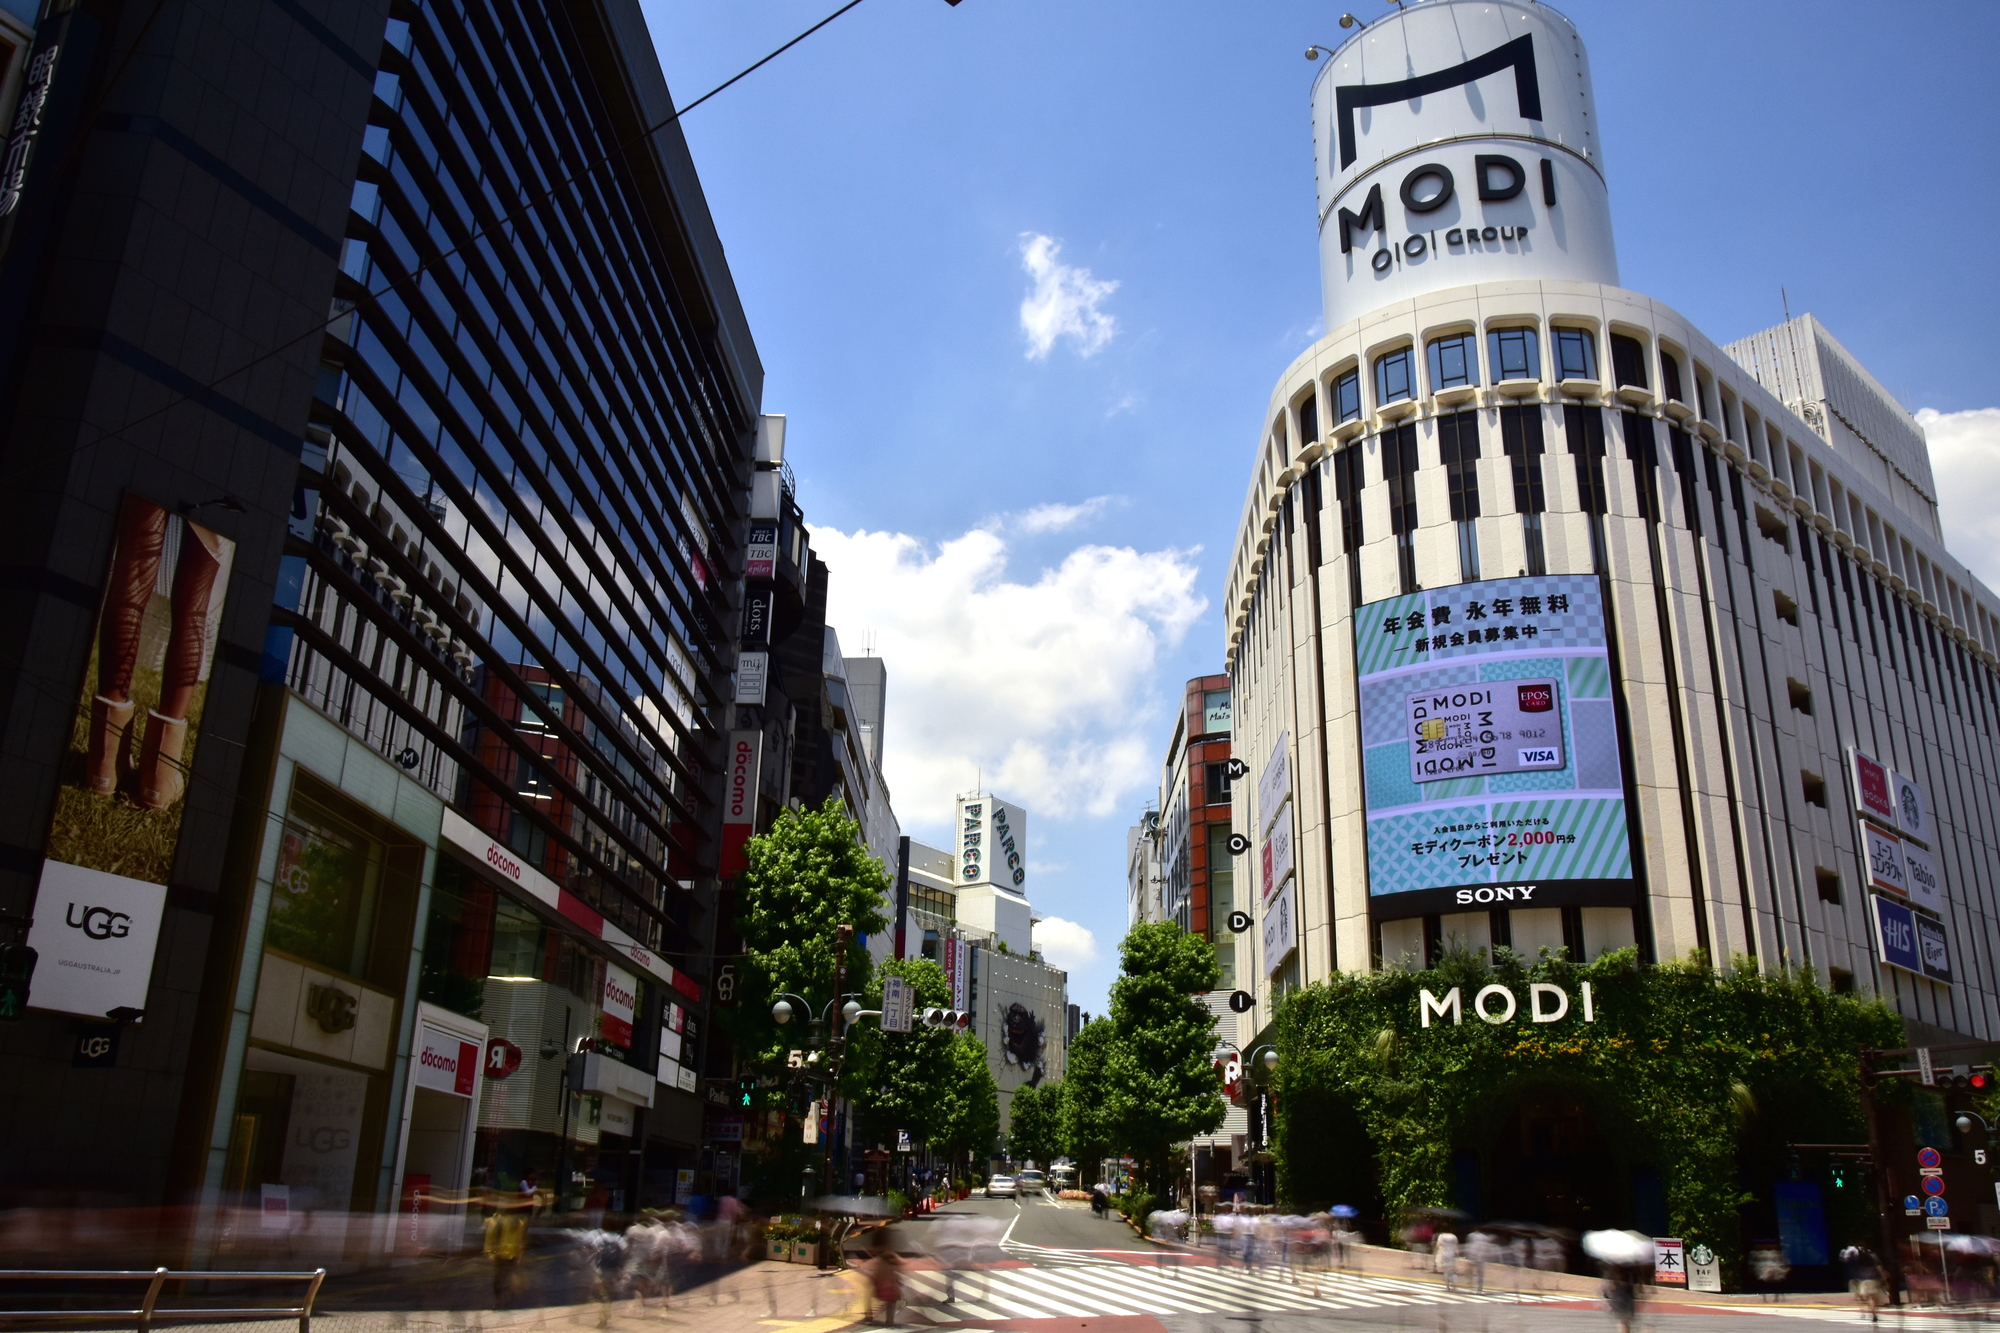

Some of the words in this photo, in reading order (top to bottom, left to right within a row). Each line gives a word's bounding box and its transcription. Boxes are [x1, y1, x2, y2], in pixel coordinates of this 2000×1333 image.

[1338, 154, 1556, 254] MODI
[1445, 226, 1528, 246] GROUP
[751, 533, 773, 543] TBC
[750, 549, 772, 558] TBC
[750, 598, 766, 635] dots.
[1383, 605, 1451, 635] 年会費
[1466, 594, 1569, 621] 永年無料
[1415, 624, 1538, 653] 新規会員募集中
[1433, 690, 1491, 711] MODI
[1521, 691, 1549, 701] EPOS
[1443, 713, 1471, 723] MODI
[1522, 750, 1555, 762] VISA
[732, 741, 753, 806] docomo
[1864, 767, 1880, 781] HMV
[1863, 789, 1889, 809] BOOKS
[963, 803, 981, 879] PARCO
[992, 806, 1025, 886] PARCO
[1875, 840, 1894, 862] エース
[487, 843, 521, 880] docomo
[1458, 851, 1528, 868] プレゼント
[1871, 854, 1903, 882] コンタクト
[1906, 856, 1936, 889] Tabio
[1456, 886, 1536, 904] SONY
[66, 902, 131, 940] UGG
[630, 943, 650, 967] docomo
[58, 958, 121, 975] UGGAUSTRALIA.JP
[605, 977, 635, 1010] docomo
[717, 965, 734, 1001] UGG
[889, 979, 901, 1028] 神南一丁目
[1420, 981, 1593, 1028] MODI
[80, 1036, 111, 1058] UGG
[421, 1046, 457, 1073] docomo
[787, 1050, 803, 1068] 5
[898, 1131, 909, 1143] P
[1974, 1149, 1986, 1165] 5
[410, 1190, 421, 1242] docomo
[1929, 1201, 1938, 1215] P
[1659, 1249, 1680, 1268] 本
